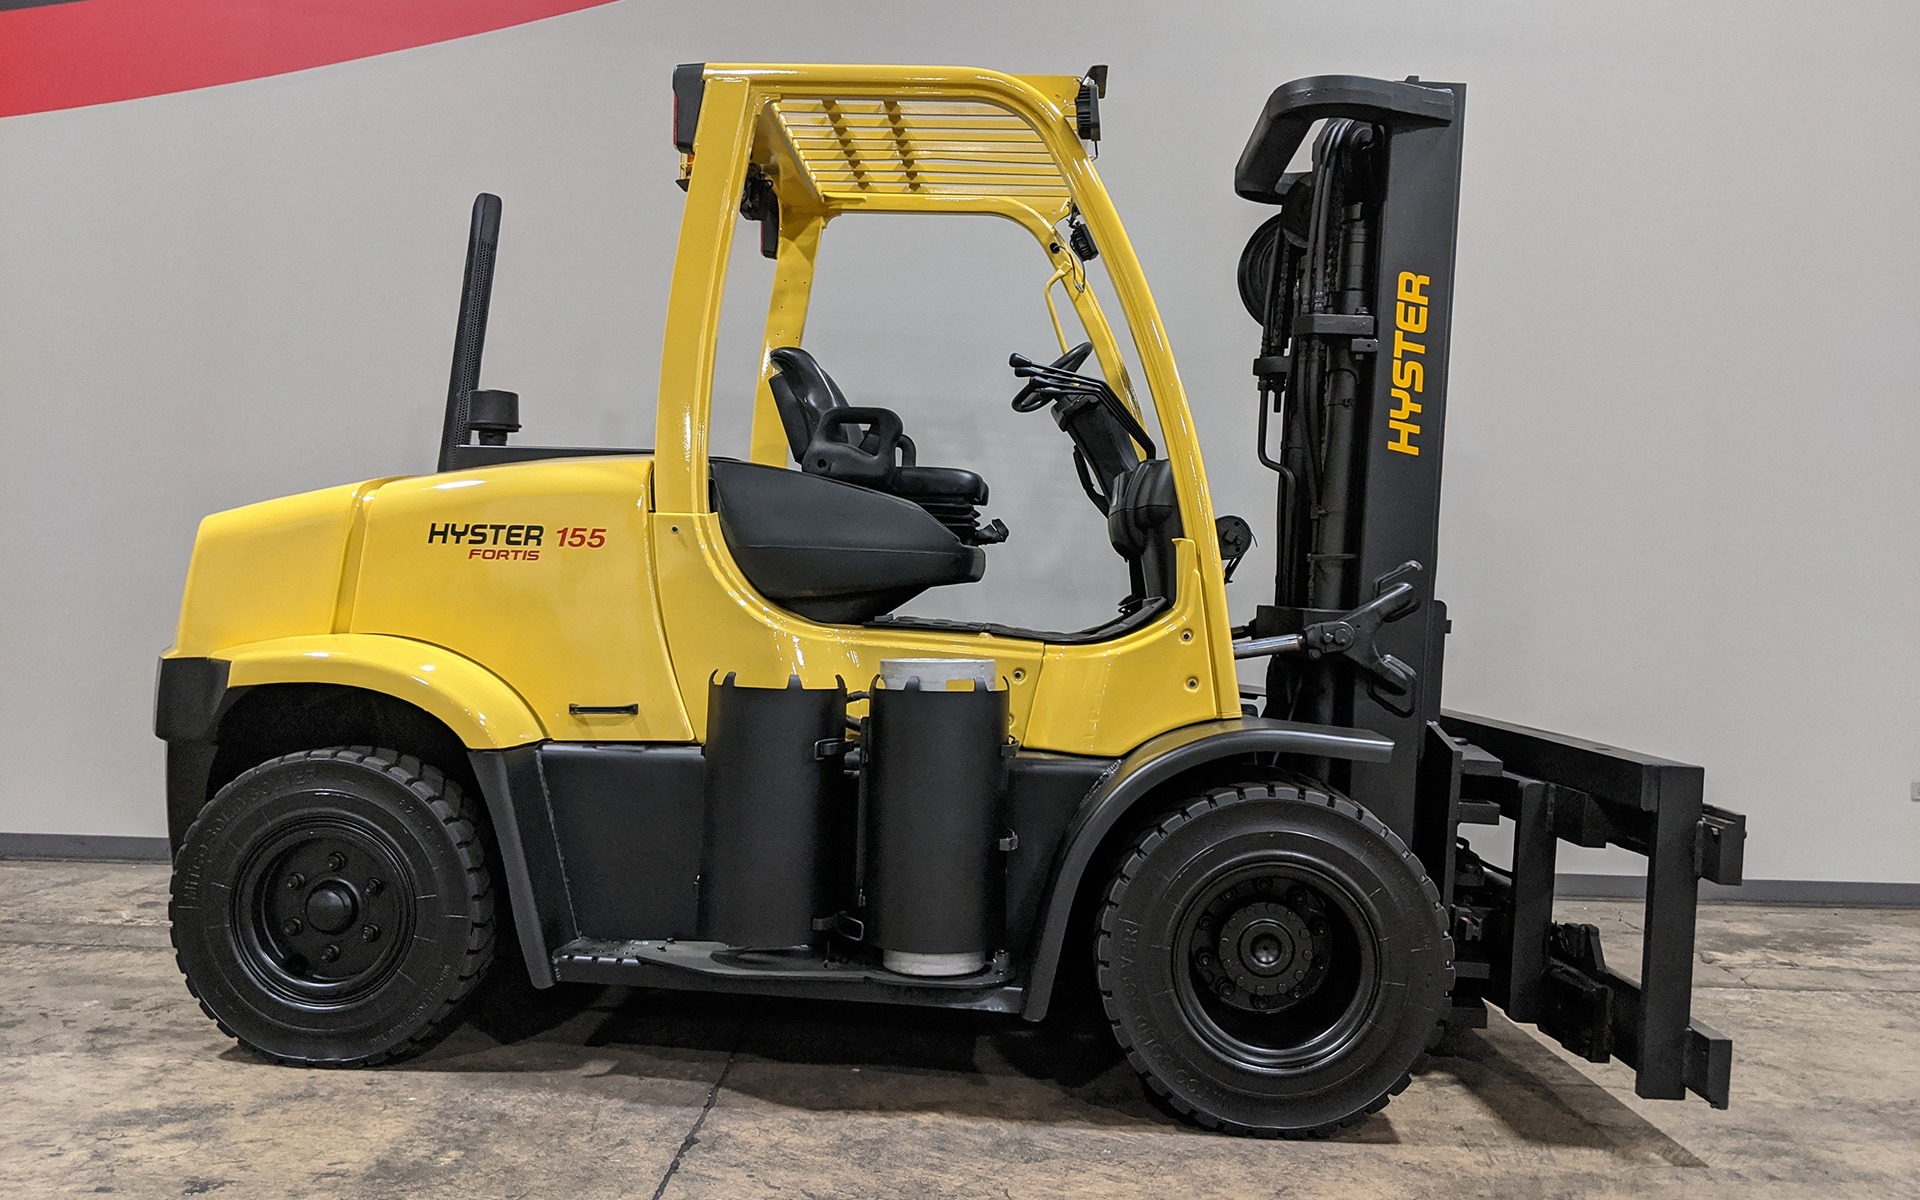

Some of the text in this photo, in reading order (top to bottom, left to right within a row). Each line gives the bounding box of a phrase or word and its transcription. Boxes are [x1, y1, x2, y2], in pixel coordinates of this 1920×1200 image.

[1387, 270, 1431, 456] HYSTER
[427, 523, 607, 548] HYSTER 155
[468, 548, 541, 561] FORTIS
